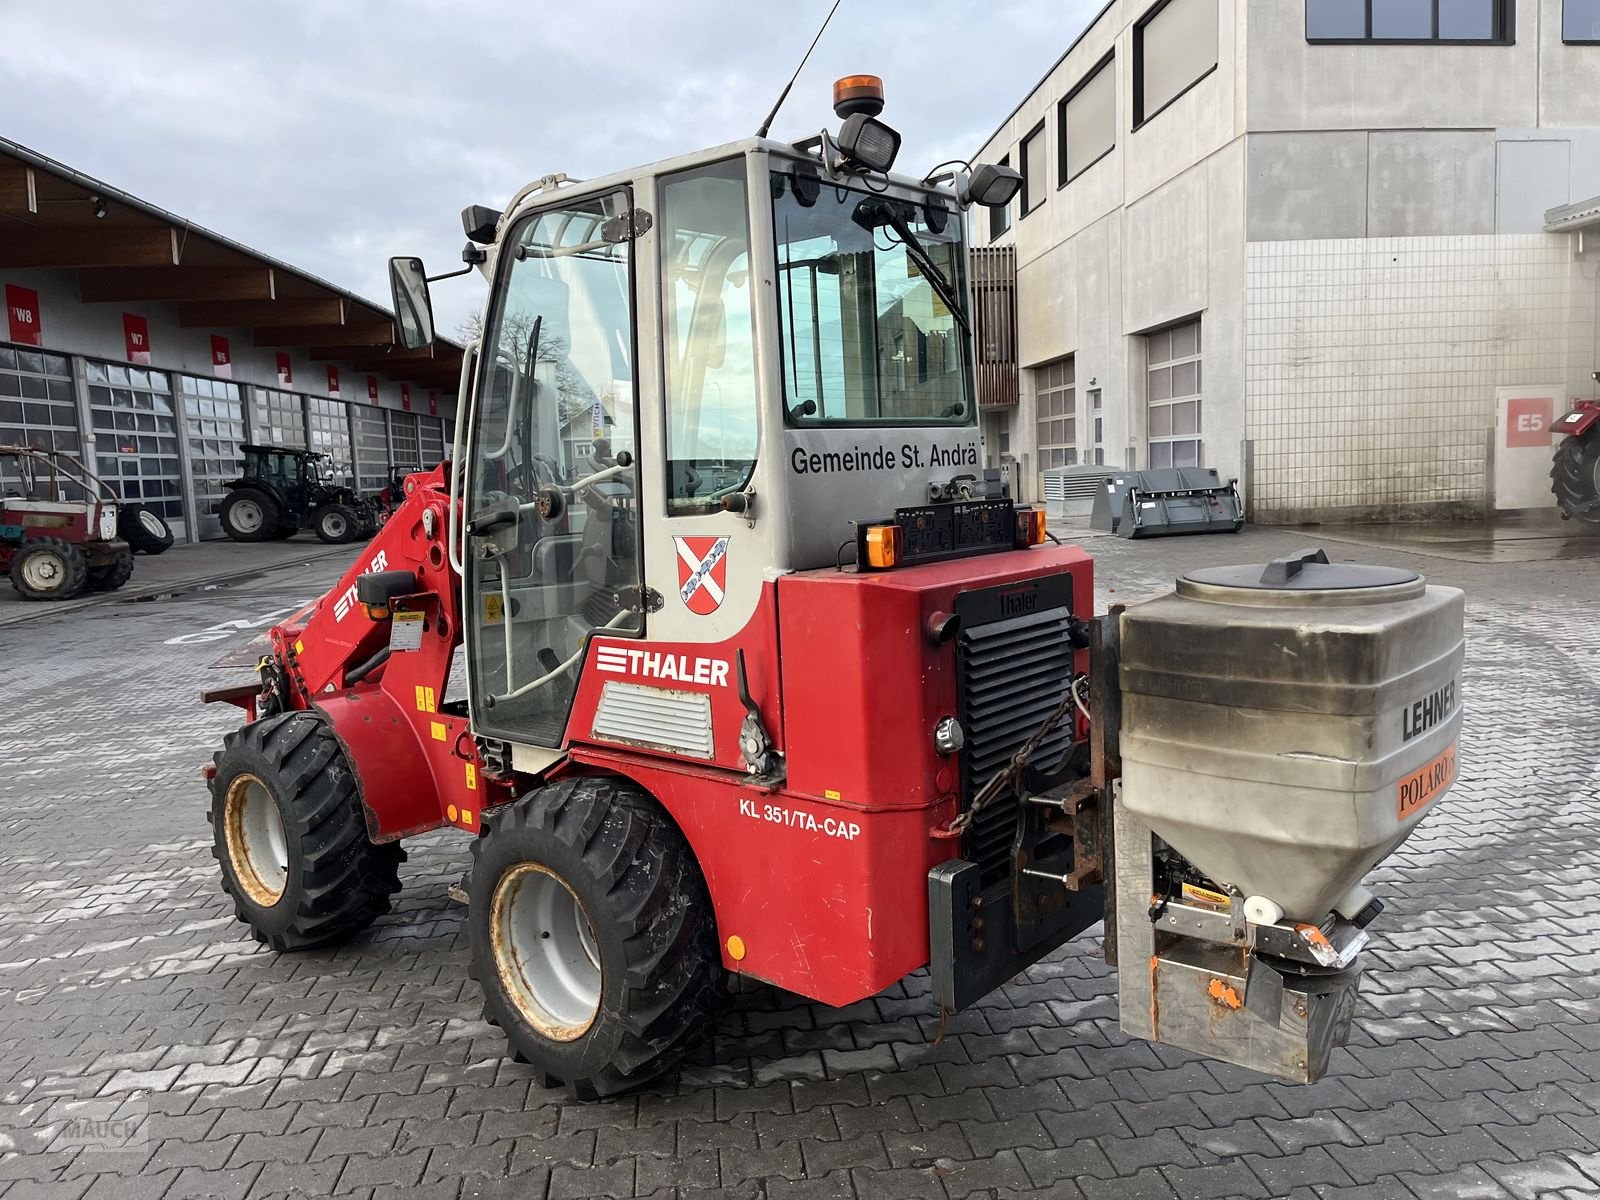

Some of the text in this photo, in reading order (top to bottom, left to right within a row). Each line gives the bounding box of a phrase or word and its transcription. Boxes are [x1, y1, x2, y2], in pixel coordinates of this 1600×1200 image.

[16, 307, 33, 324] W8
[131, 332, 143, 346] W7
[1517, 413, 1543, 432] E5
[791, 442, 977, 474] Gemeinde St. Andrä
[627, 649, 730, 687] THALER
[1402, 679, 1455, 742] LEHNER
[739, 798, 861, 841] KL 351/TA-CAP
